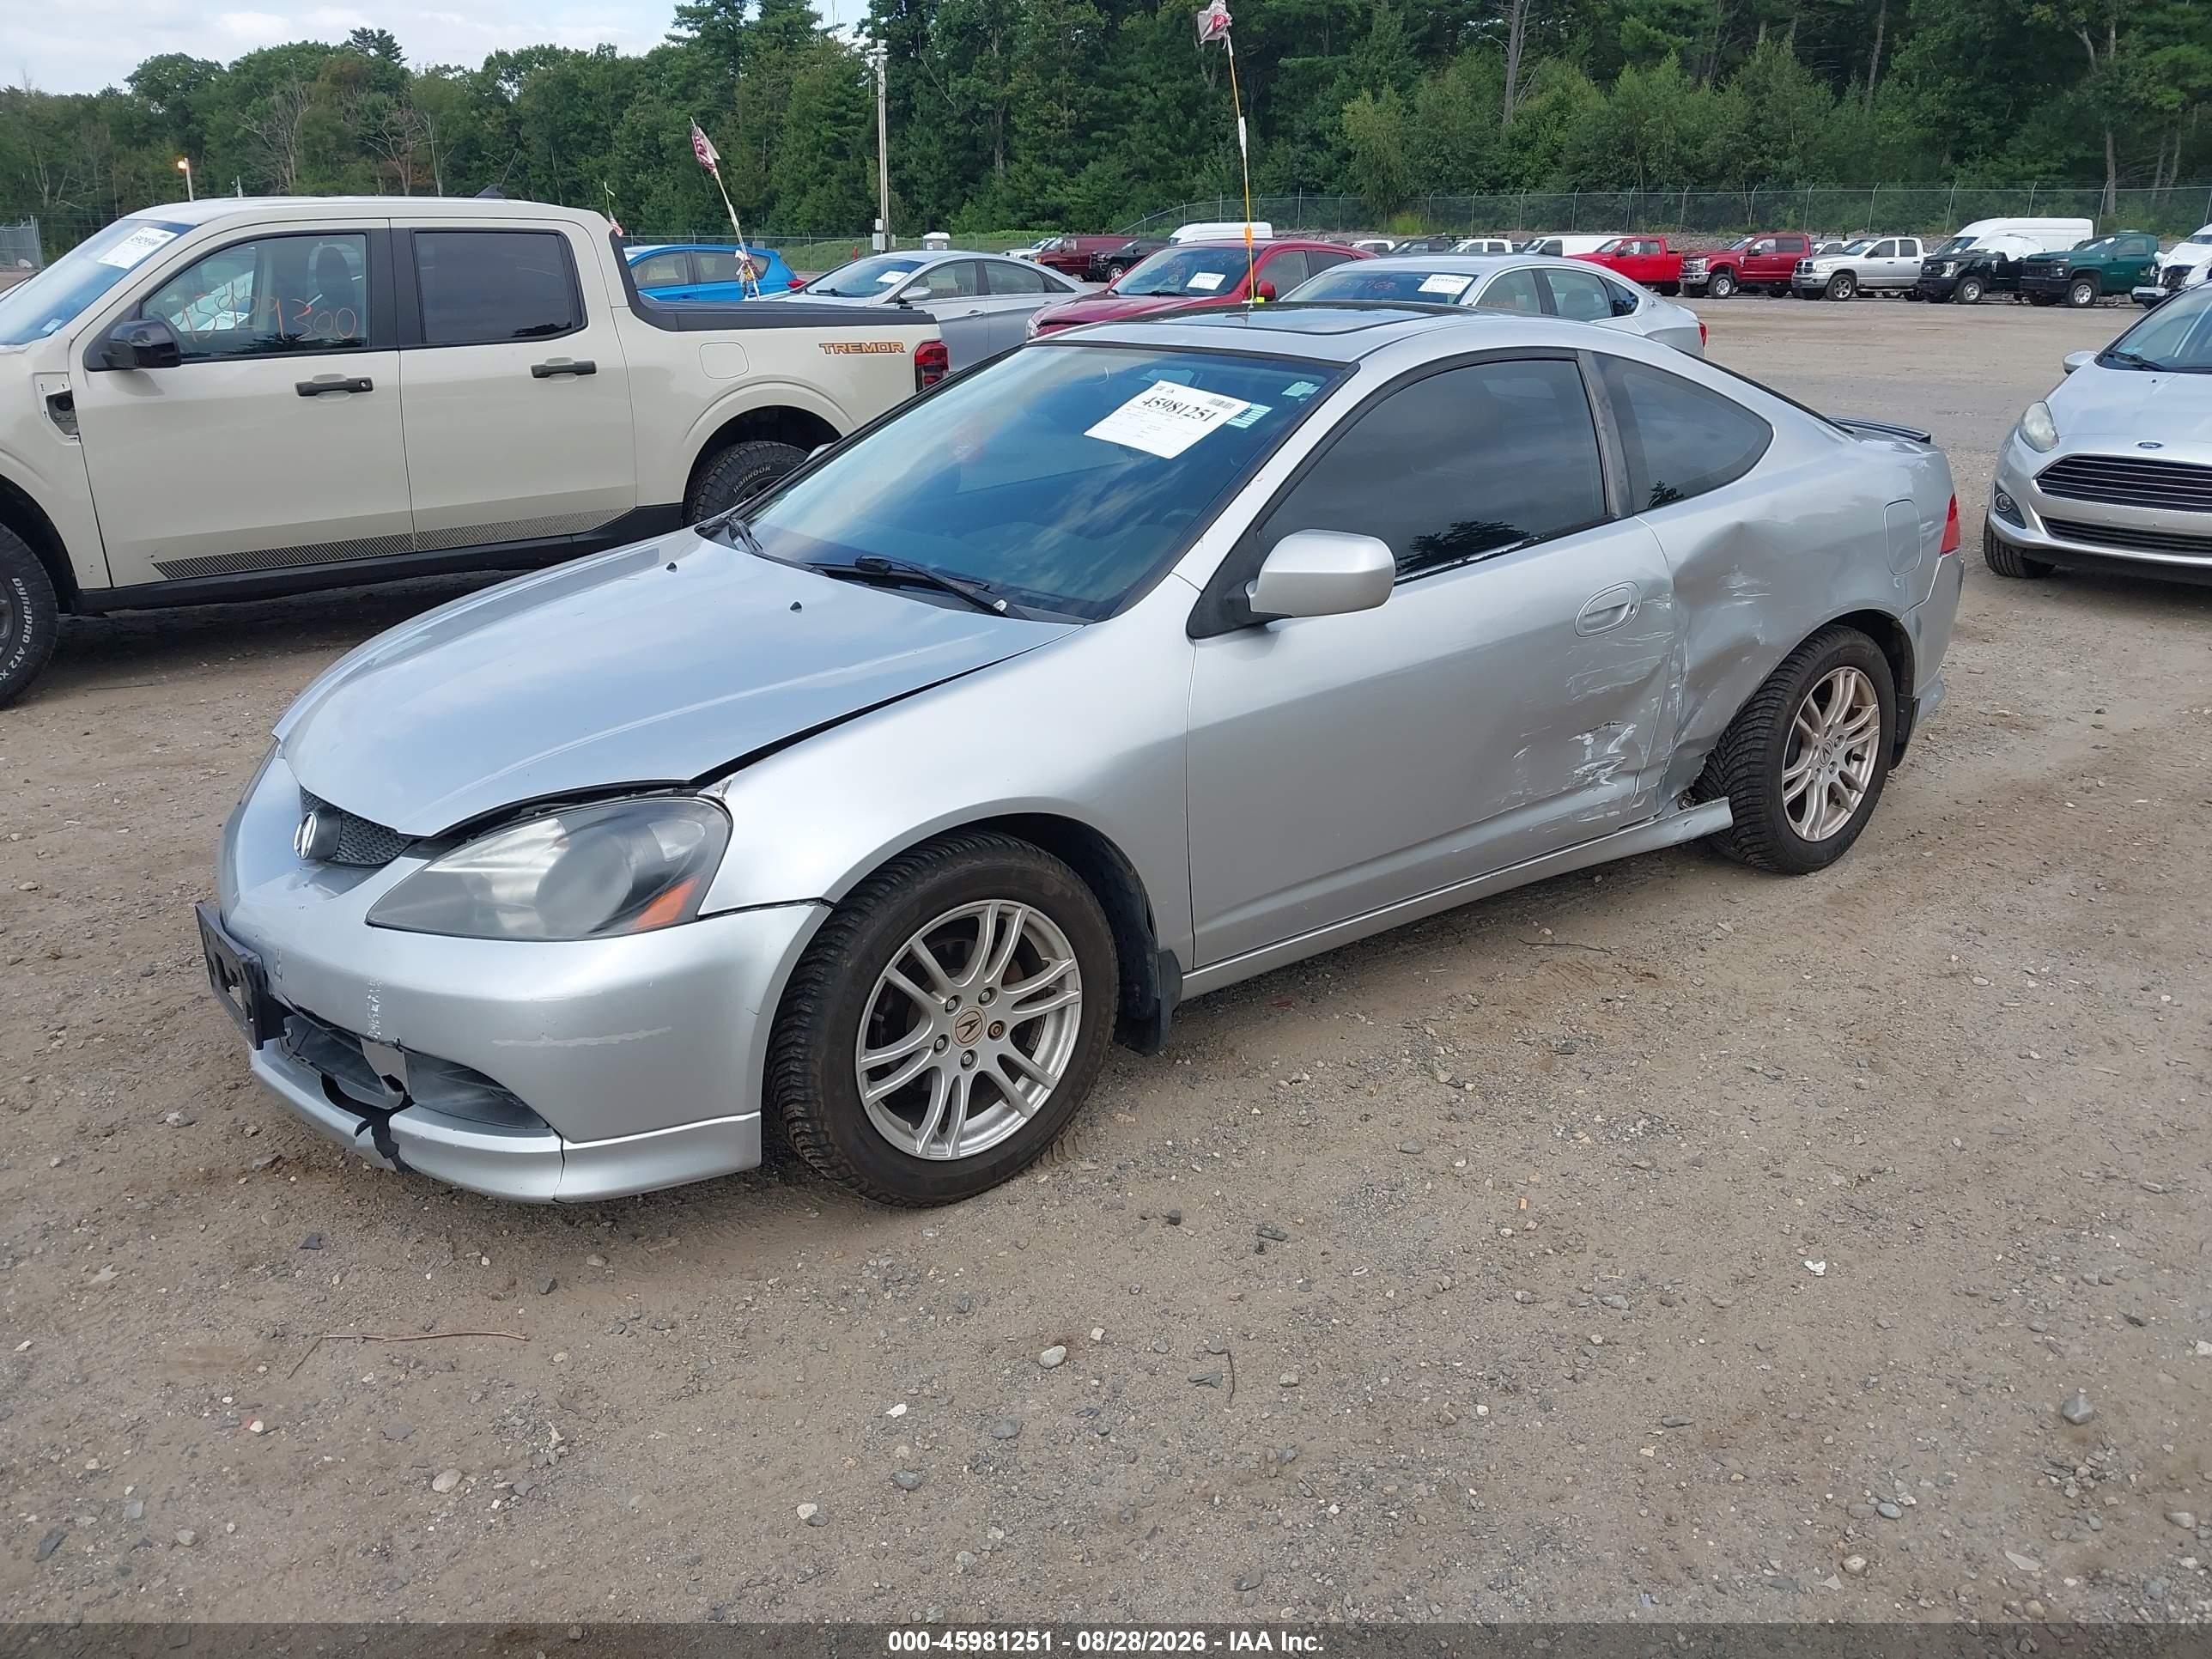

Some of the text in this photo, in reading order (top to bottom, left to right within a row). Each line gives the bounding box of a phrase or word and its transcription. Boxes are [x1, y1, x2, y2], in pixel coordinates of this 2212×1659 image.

[818, 342, 906, 355] TREMOR
[1141, 395, 1218, 422] 45981251
[9, 646, 26, 669] AT2
